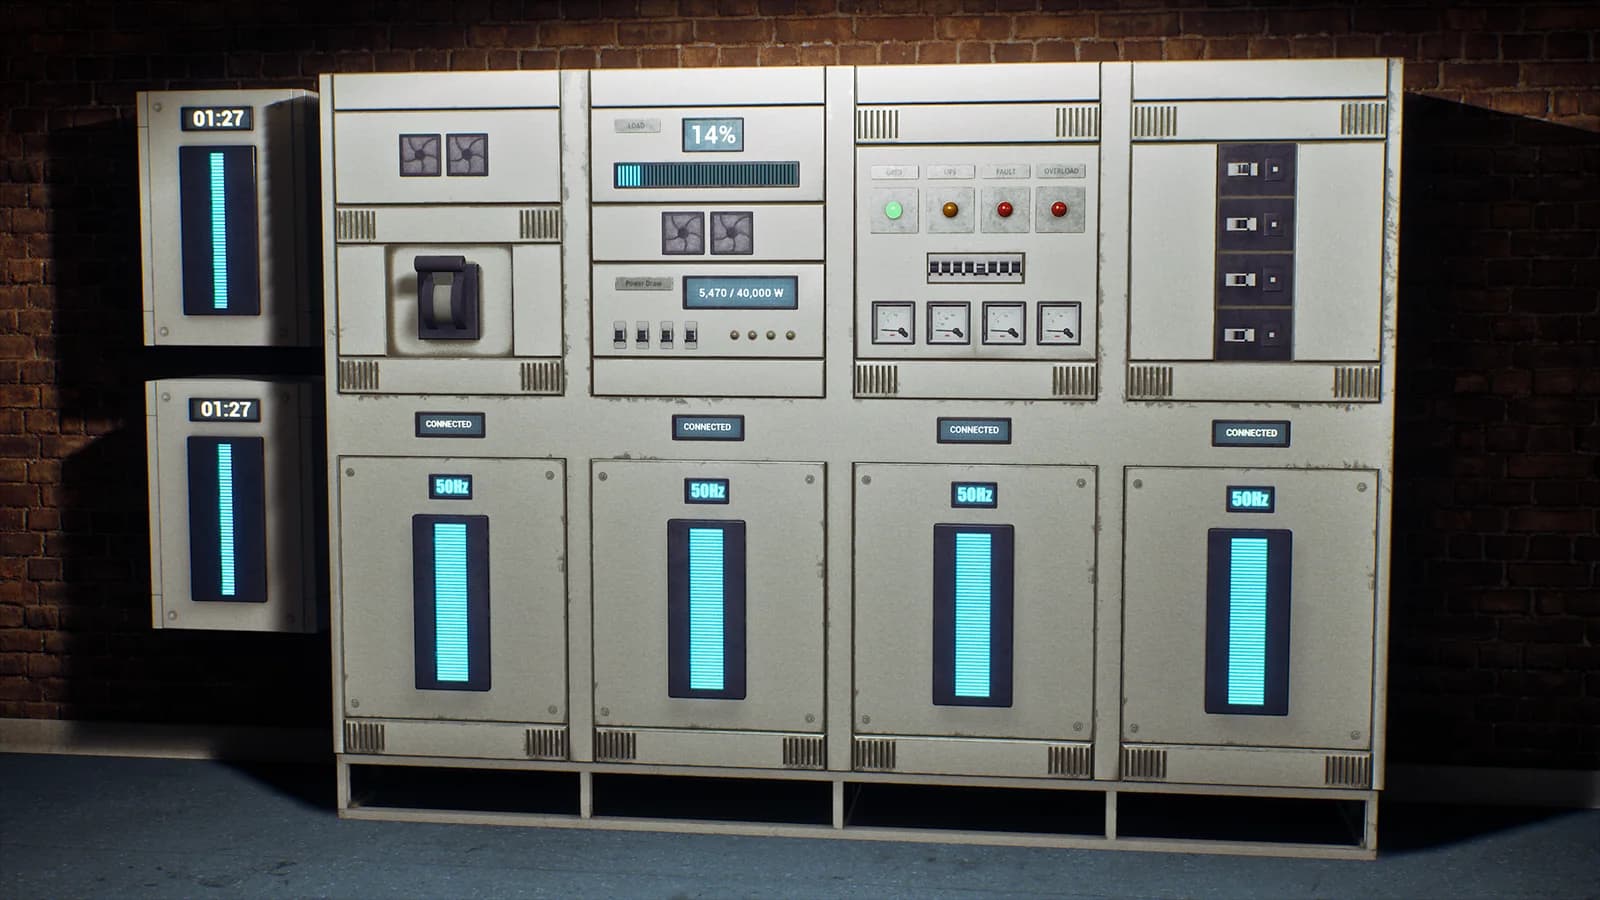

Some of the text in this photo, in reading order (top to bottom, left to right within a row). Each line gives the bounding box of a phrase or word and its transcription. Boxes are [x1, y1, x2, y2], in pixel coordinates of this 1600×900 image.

[193, 109, 245, 127] 01:27
[692, 124, 737, 145] 14%
[996, 168, 1016, 176] FAULT
[1044, 167, 1080, 175] OVERLOAD
[625, 279, 662, 287] Power Draw
[699, 287, 728, 300] 5,470
[736, 287, 772, 300] 40,000
[774, 288, 784, 298] W
[200, 400, 252, 418] 01:27
[425, 419, 473, 429] CONNECTED
[683, 422, 732, 432] CONNECTED
[949, 425, 1000, 435] CONNECTED
[1225, 428, 1278, 438] CONNECTED
[435, 479, 470, 496] 50Hz
[689, 482, 727, 500] 50Hz
[957, 486, 993, 503] 50Hz
[1231, 489, 1270, 508] 50Hz
